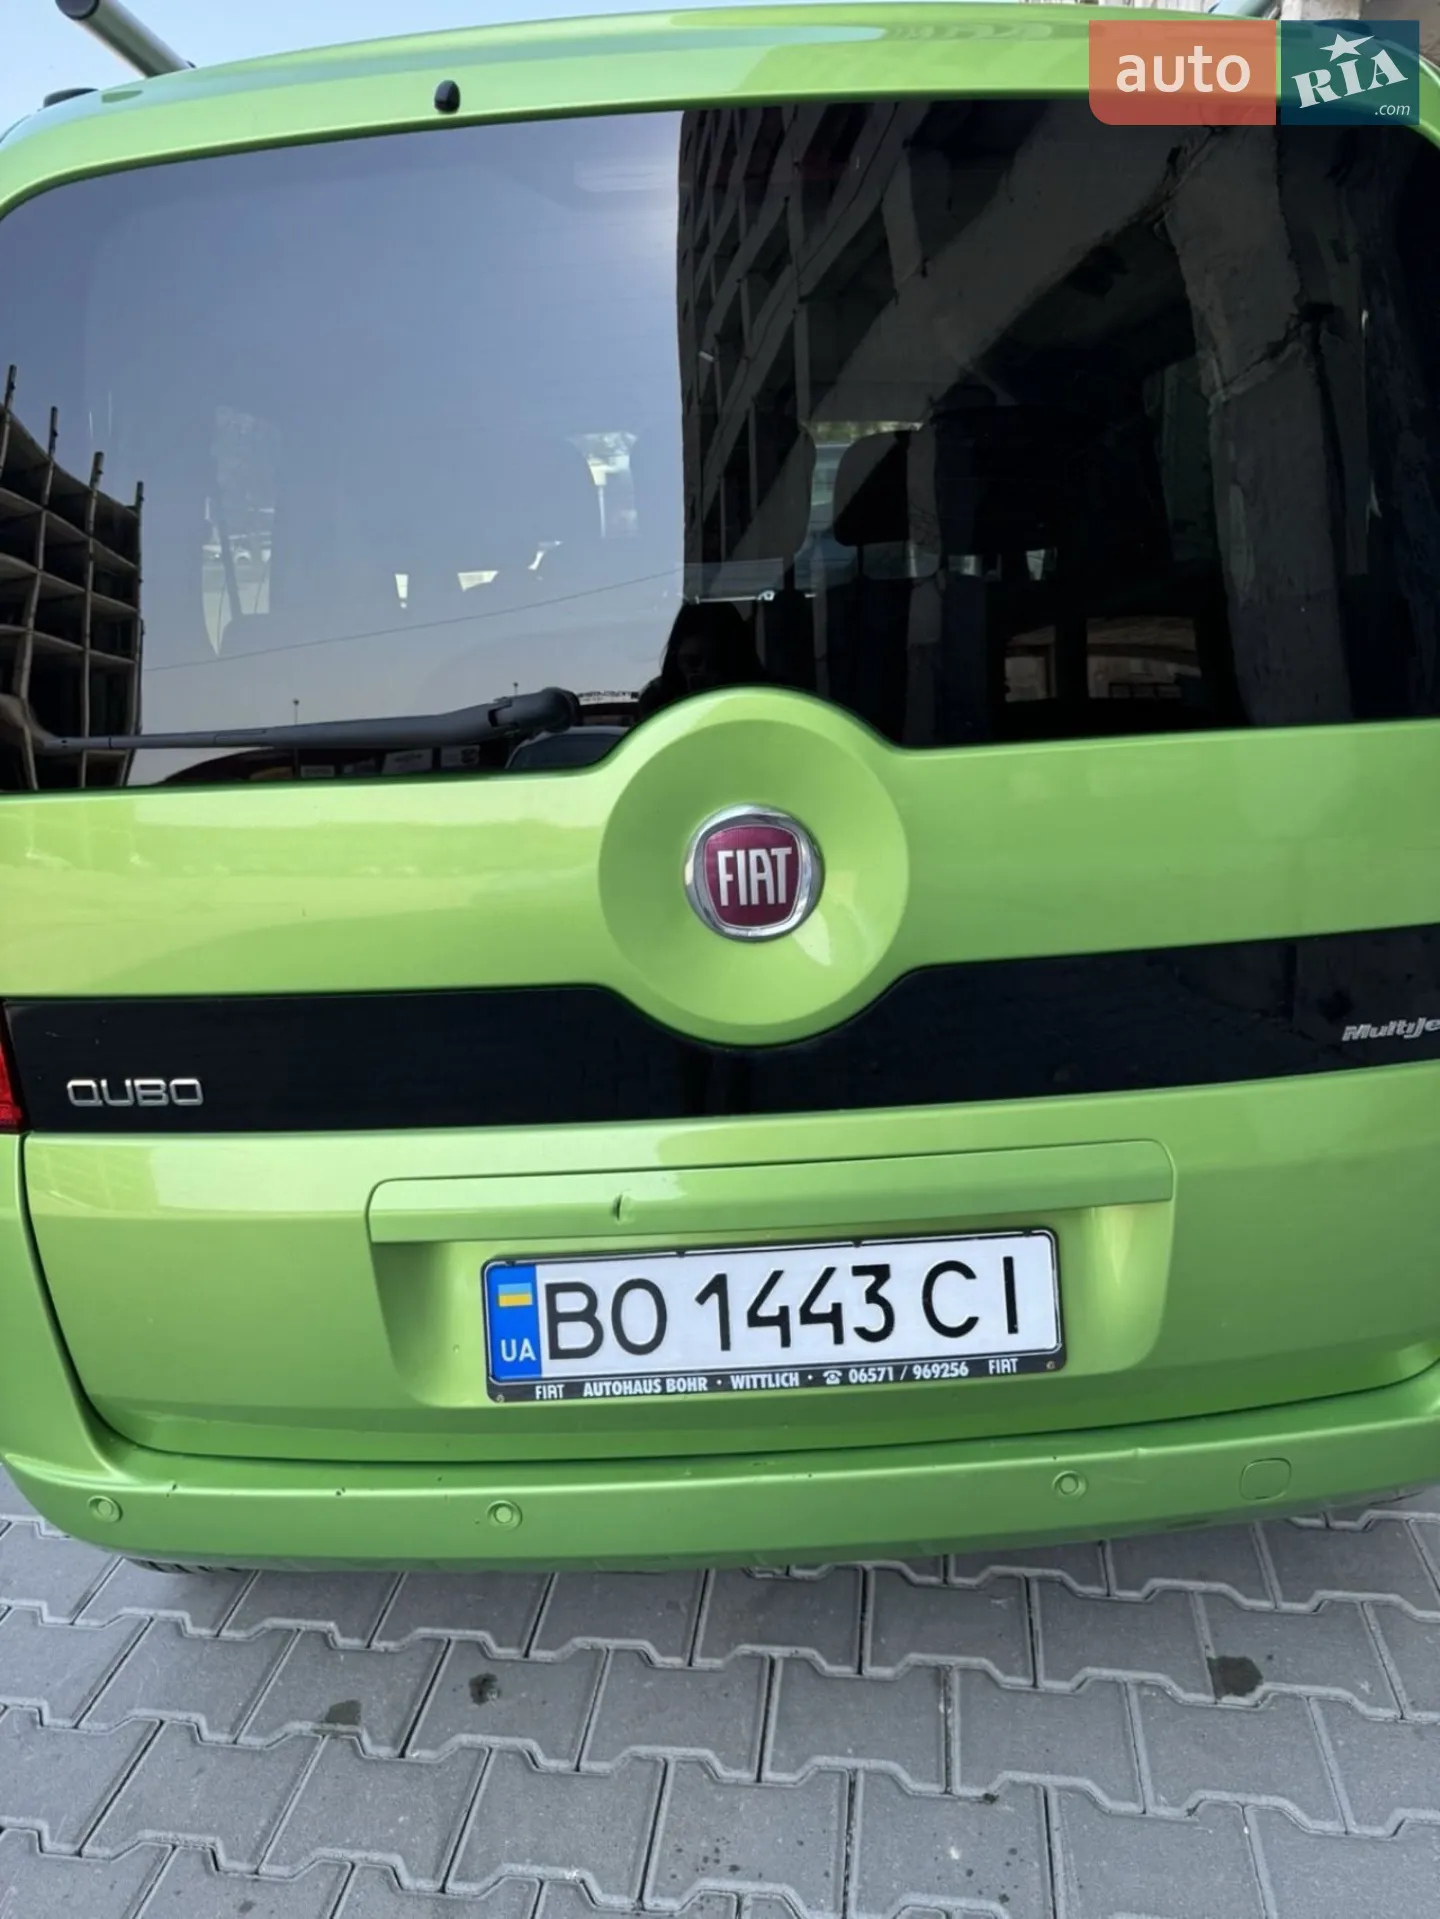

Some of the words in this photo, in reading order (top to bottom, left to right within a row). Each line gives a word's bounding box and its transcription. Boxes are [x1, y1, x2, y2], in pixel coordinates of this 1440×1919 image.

[717, 846, 793, 907] FIAT
[66, 1078, 204, 1107] QUBO
[544, 1277, 668, 1360] BO
[694, 1263, 896, 1351] 1443
[921, 1255, 1019, 1339] CI
[500, 1338, 538, 1362] UA
[535, 1384, 565, 1400] FIAT
[583, 1377, 662, 1397] AUTOHAUS
[666, 1375, 709, 1393] BOHR
[730, 1371, 800, 1390] WITTLICH
[848, 1366, 894, 1384] 06571
[913, 1361, 970, 1380] 969256
[988, 1357, 1019, 1375] FIAT
